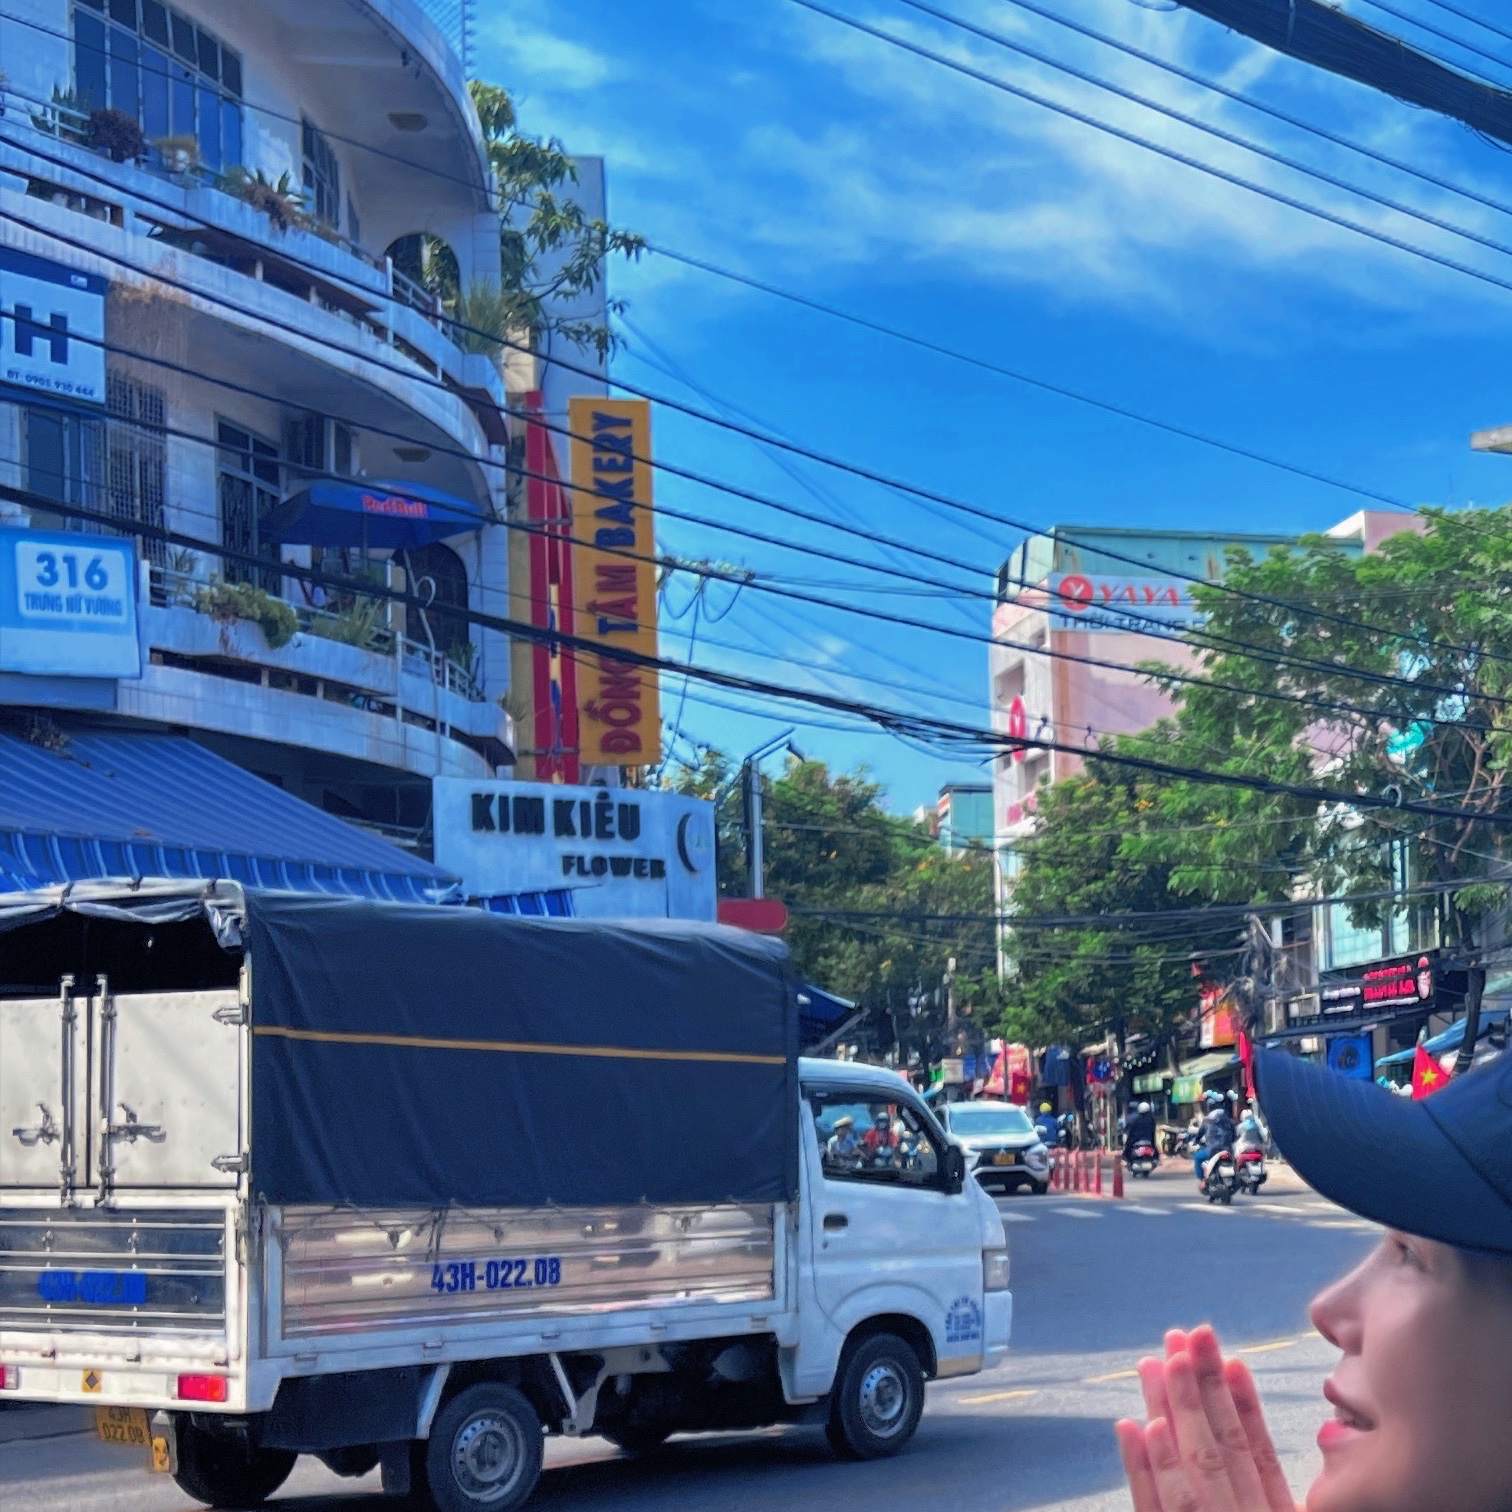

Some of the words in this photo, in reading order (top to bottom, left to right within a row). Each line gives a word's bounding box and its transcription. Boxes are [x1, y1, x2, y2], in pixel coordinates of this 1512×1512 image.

[592, 411, 636, 547] BAKERY
[36, 553, 108, 591] 316
[586, 564, 639, 636] TÂM
[1100, 584, 1180, 608] YAYA
[471, 793, 546, 834] KIM
[563, 855, 666, 879] FLOWER
[430, 1257, 561, 1293] 43H-022.08
